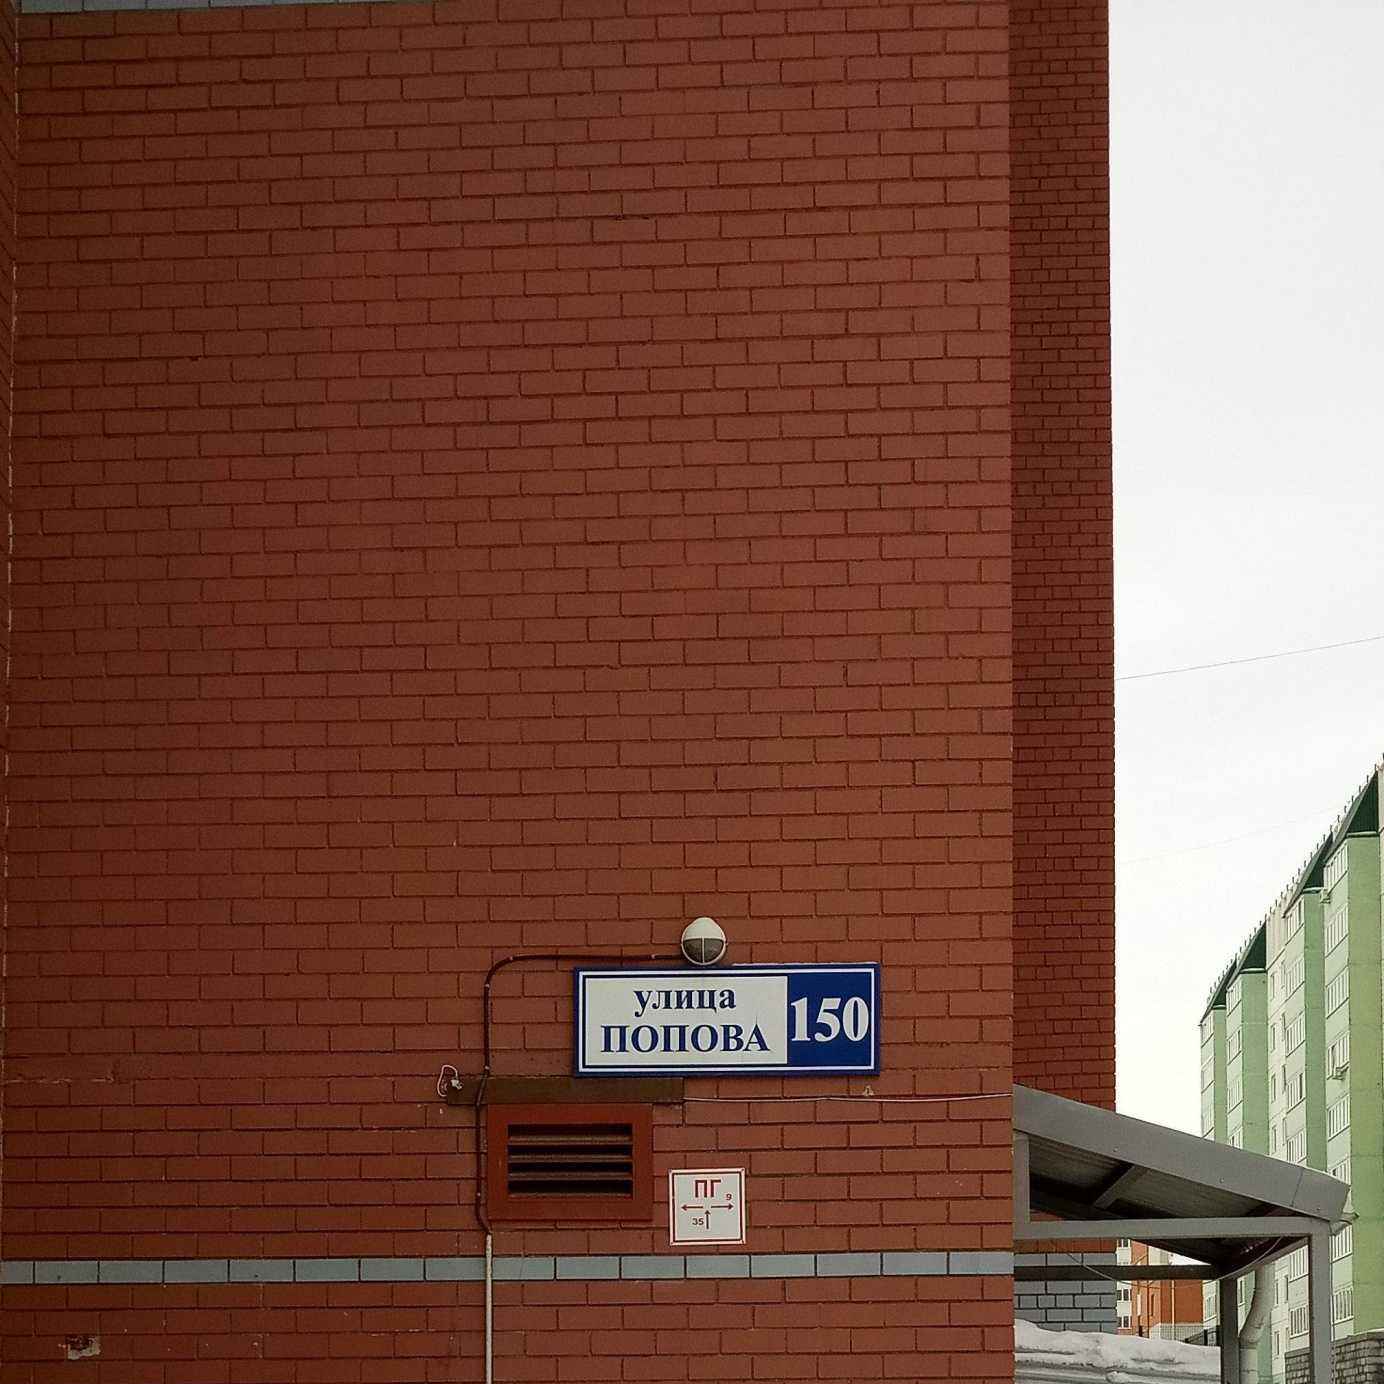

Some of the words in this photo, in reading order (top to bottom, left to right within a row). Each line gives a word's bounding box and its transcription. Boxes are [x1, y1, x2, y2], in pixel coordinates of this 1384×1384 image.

[633, 988, 737, 1018] улица
[790, 996, 870, 1043] 150
[600, 1023, 771, 1053] ПОПОВА
[694, 1179, 722, 1198] ПГ
[725, 1193, 733, 1201] 9
[691, 1217, 706, 1226] 35
